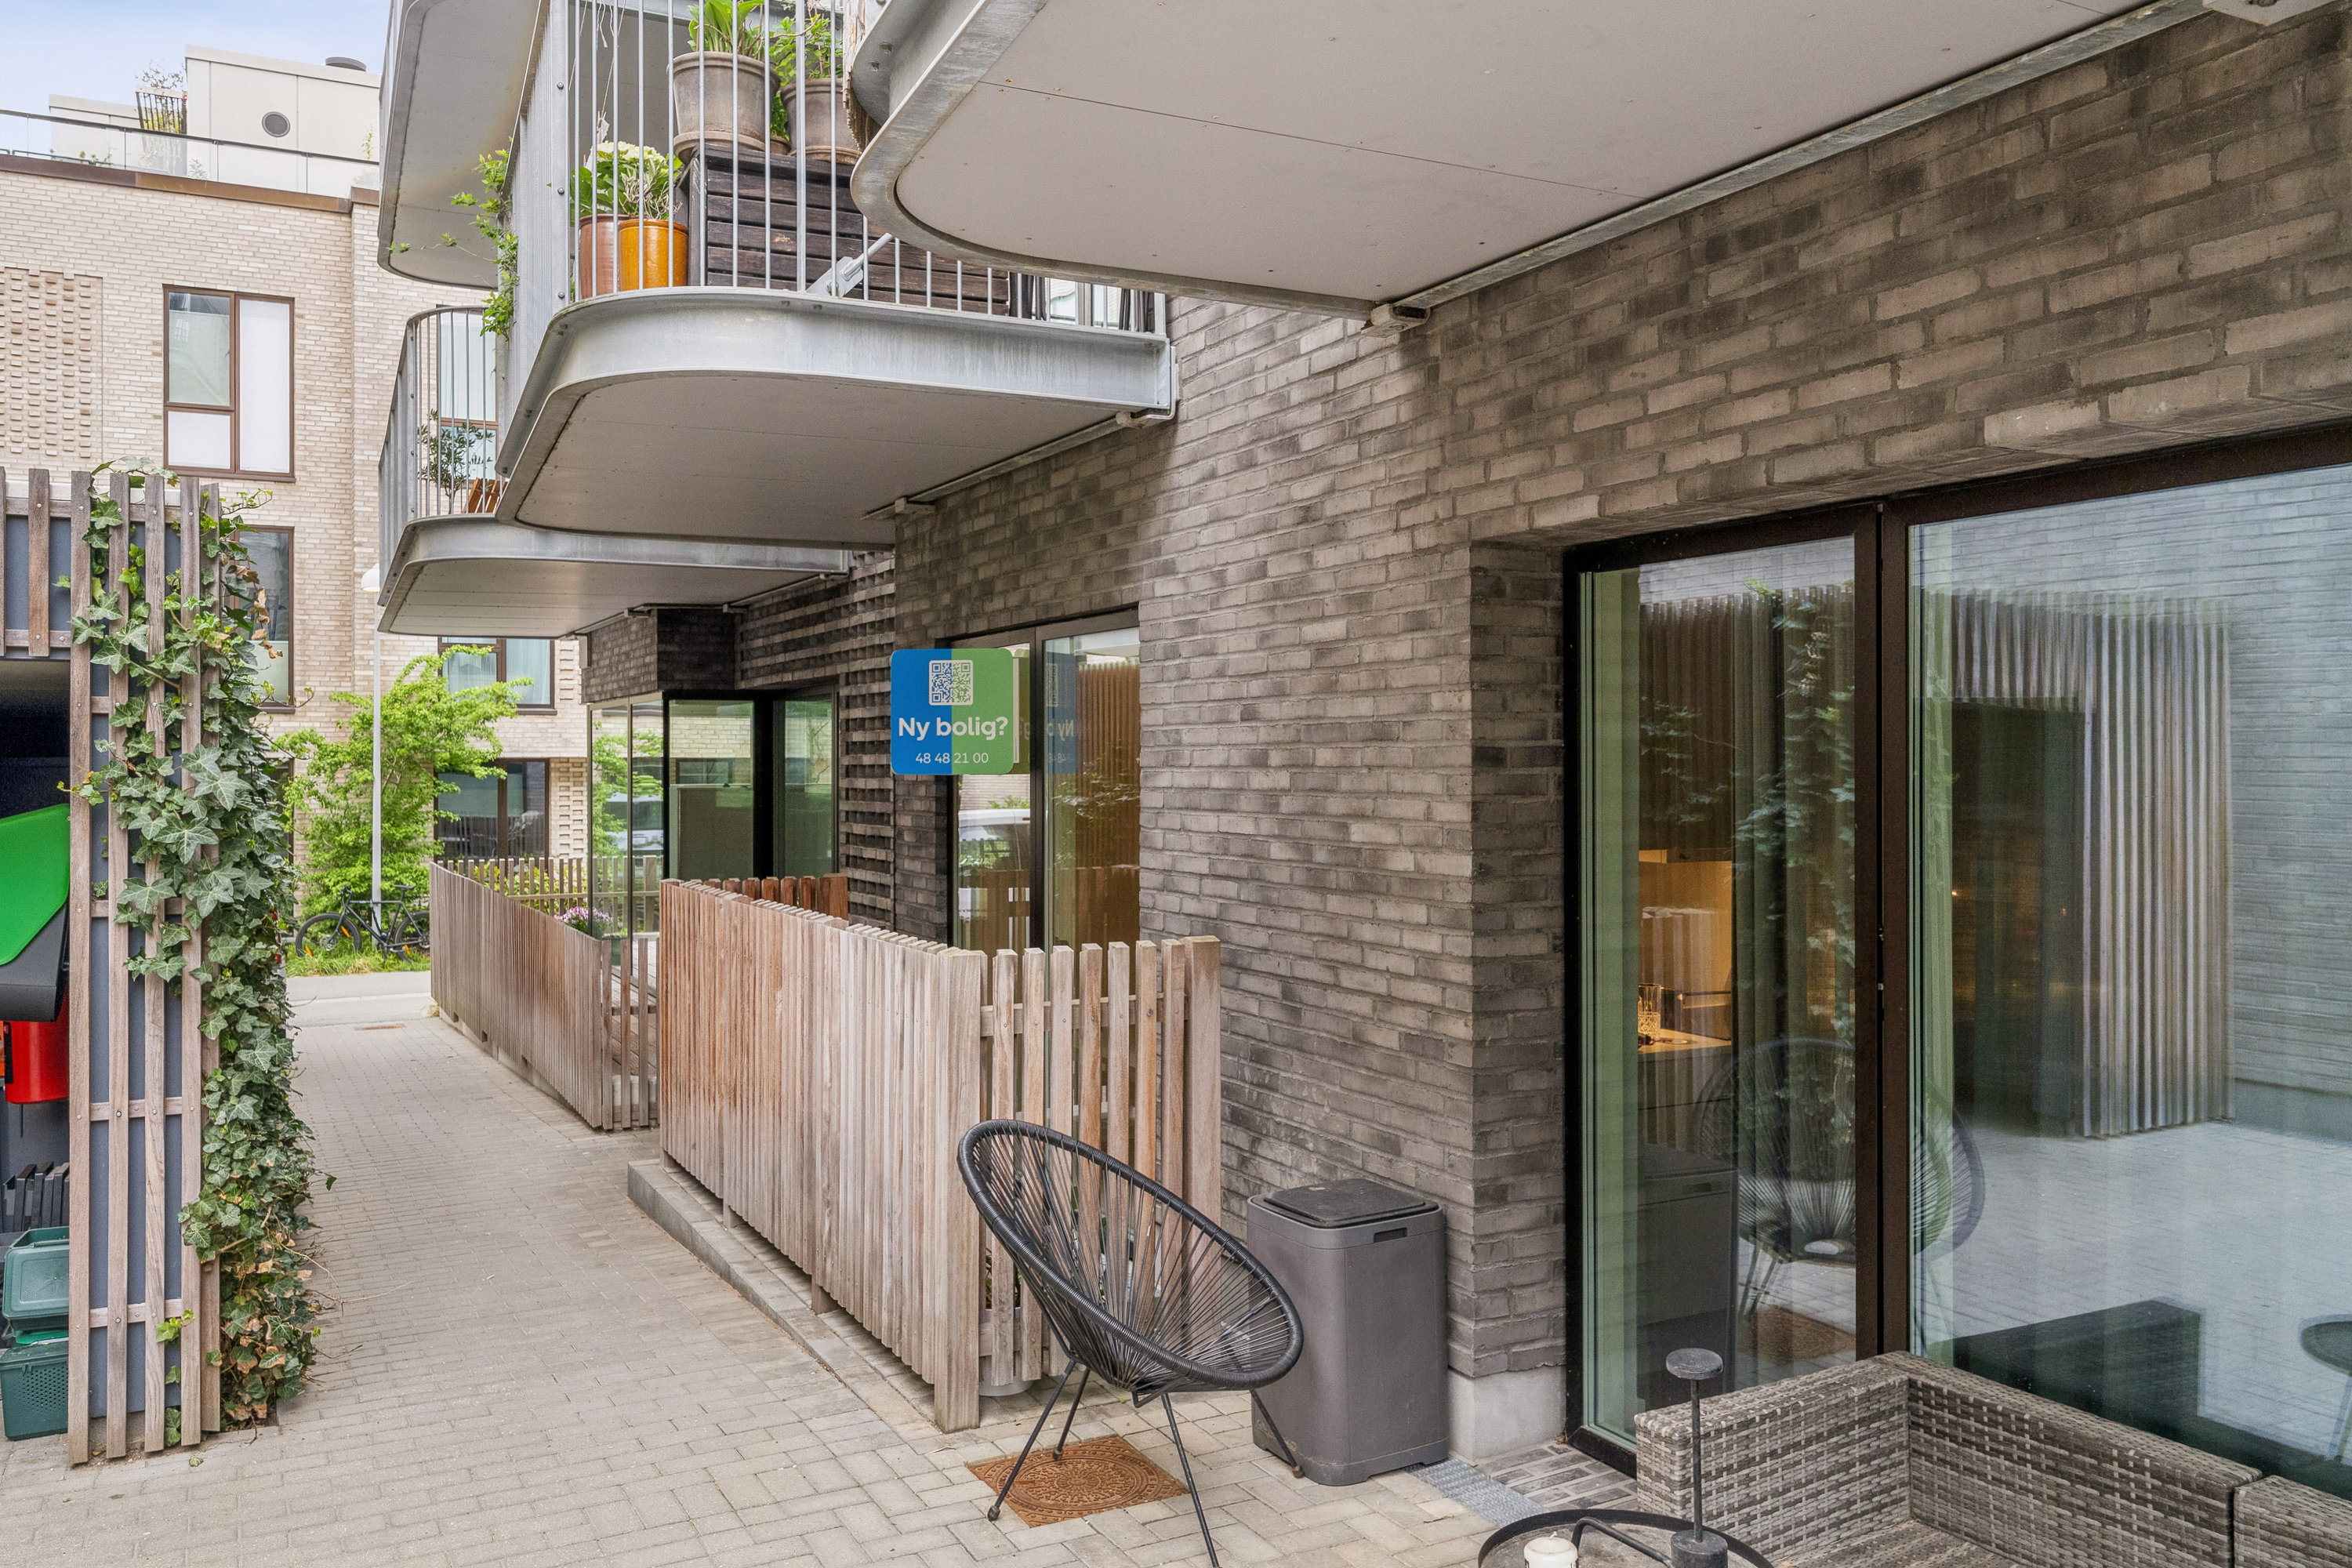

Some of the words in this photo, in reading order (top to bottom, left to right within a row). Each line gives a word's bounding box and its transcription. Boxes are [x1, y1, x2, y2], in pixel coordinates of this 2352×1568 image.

[898, 717, 931, 741] Ny
[936, 717, 1009, 741] bolig?
[915, 753, 931, 764] 48
[935, 753, 950, 764] 48
[953, 753, 969, 764] 21
[972, 753, 989, 764] 00
